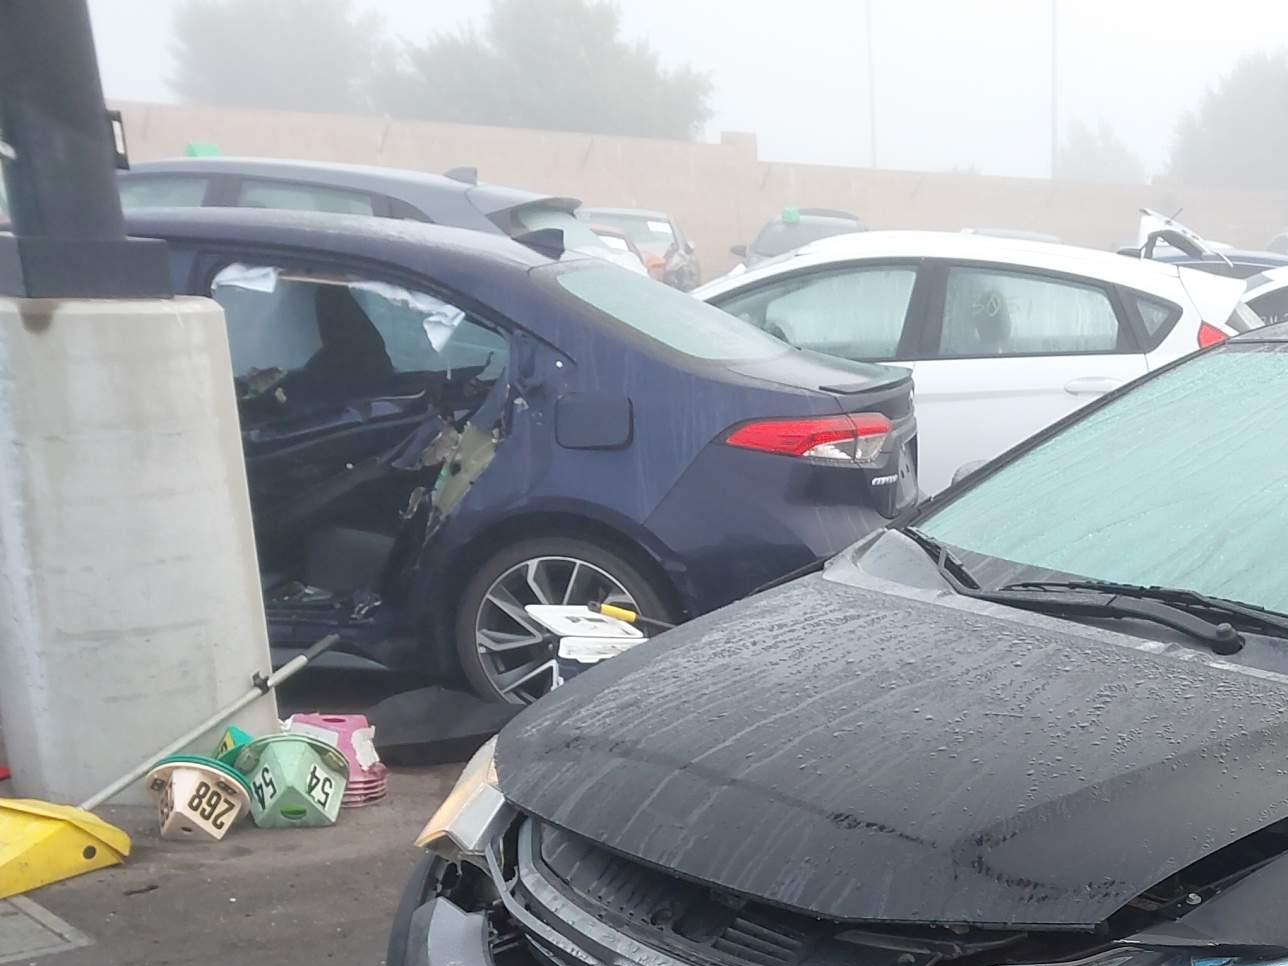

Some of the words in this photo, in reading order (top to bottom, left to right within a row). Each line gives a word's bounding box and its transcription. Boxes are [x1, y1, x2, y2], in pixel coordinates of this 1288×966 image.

[187, 781, 235, 830] 268
[252, 767, 277, 811] 54
[307, 765, 333, 807] 54
